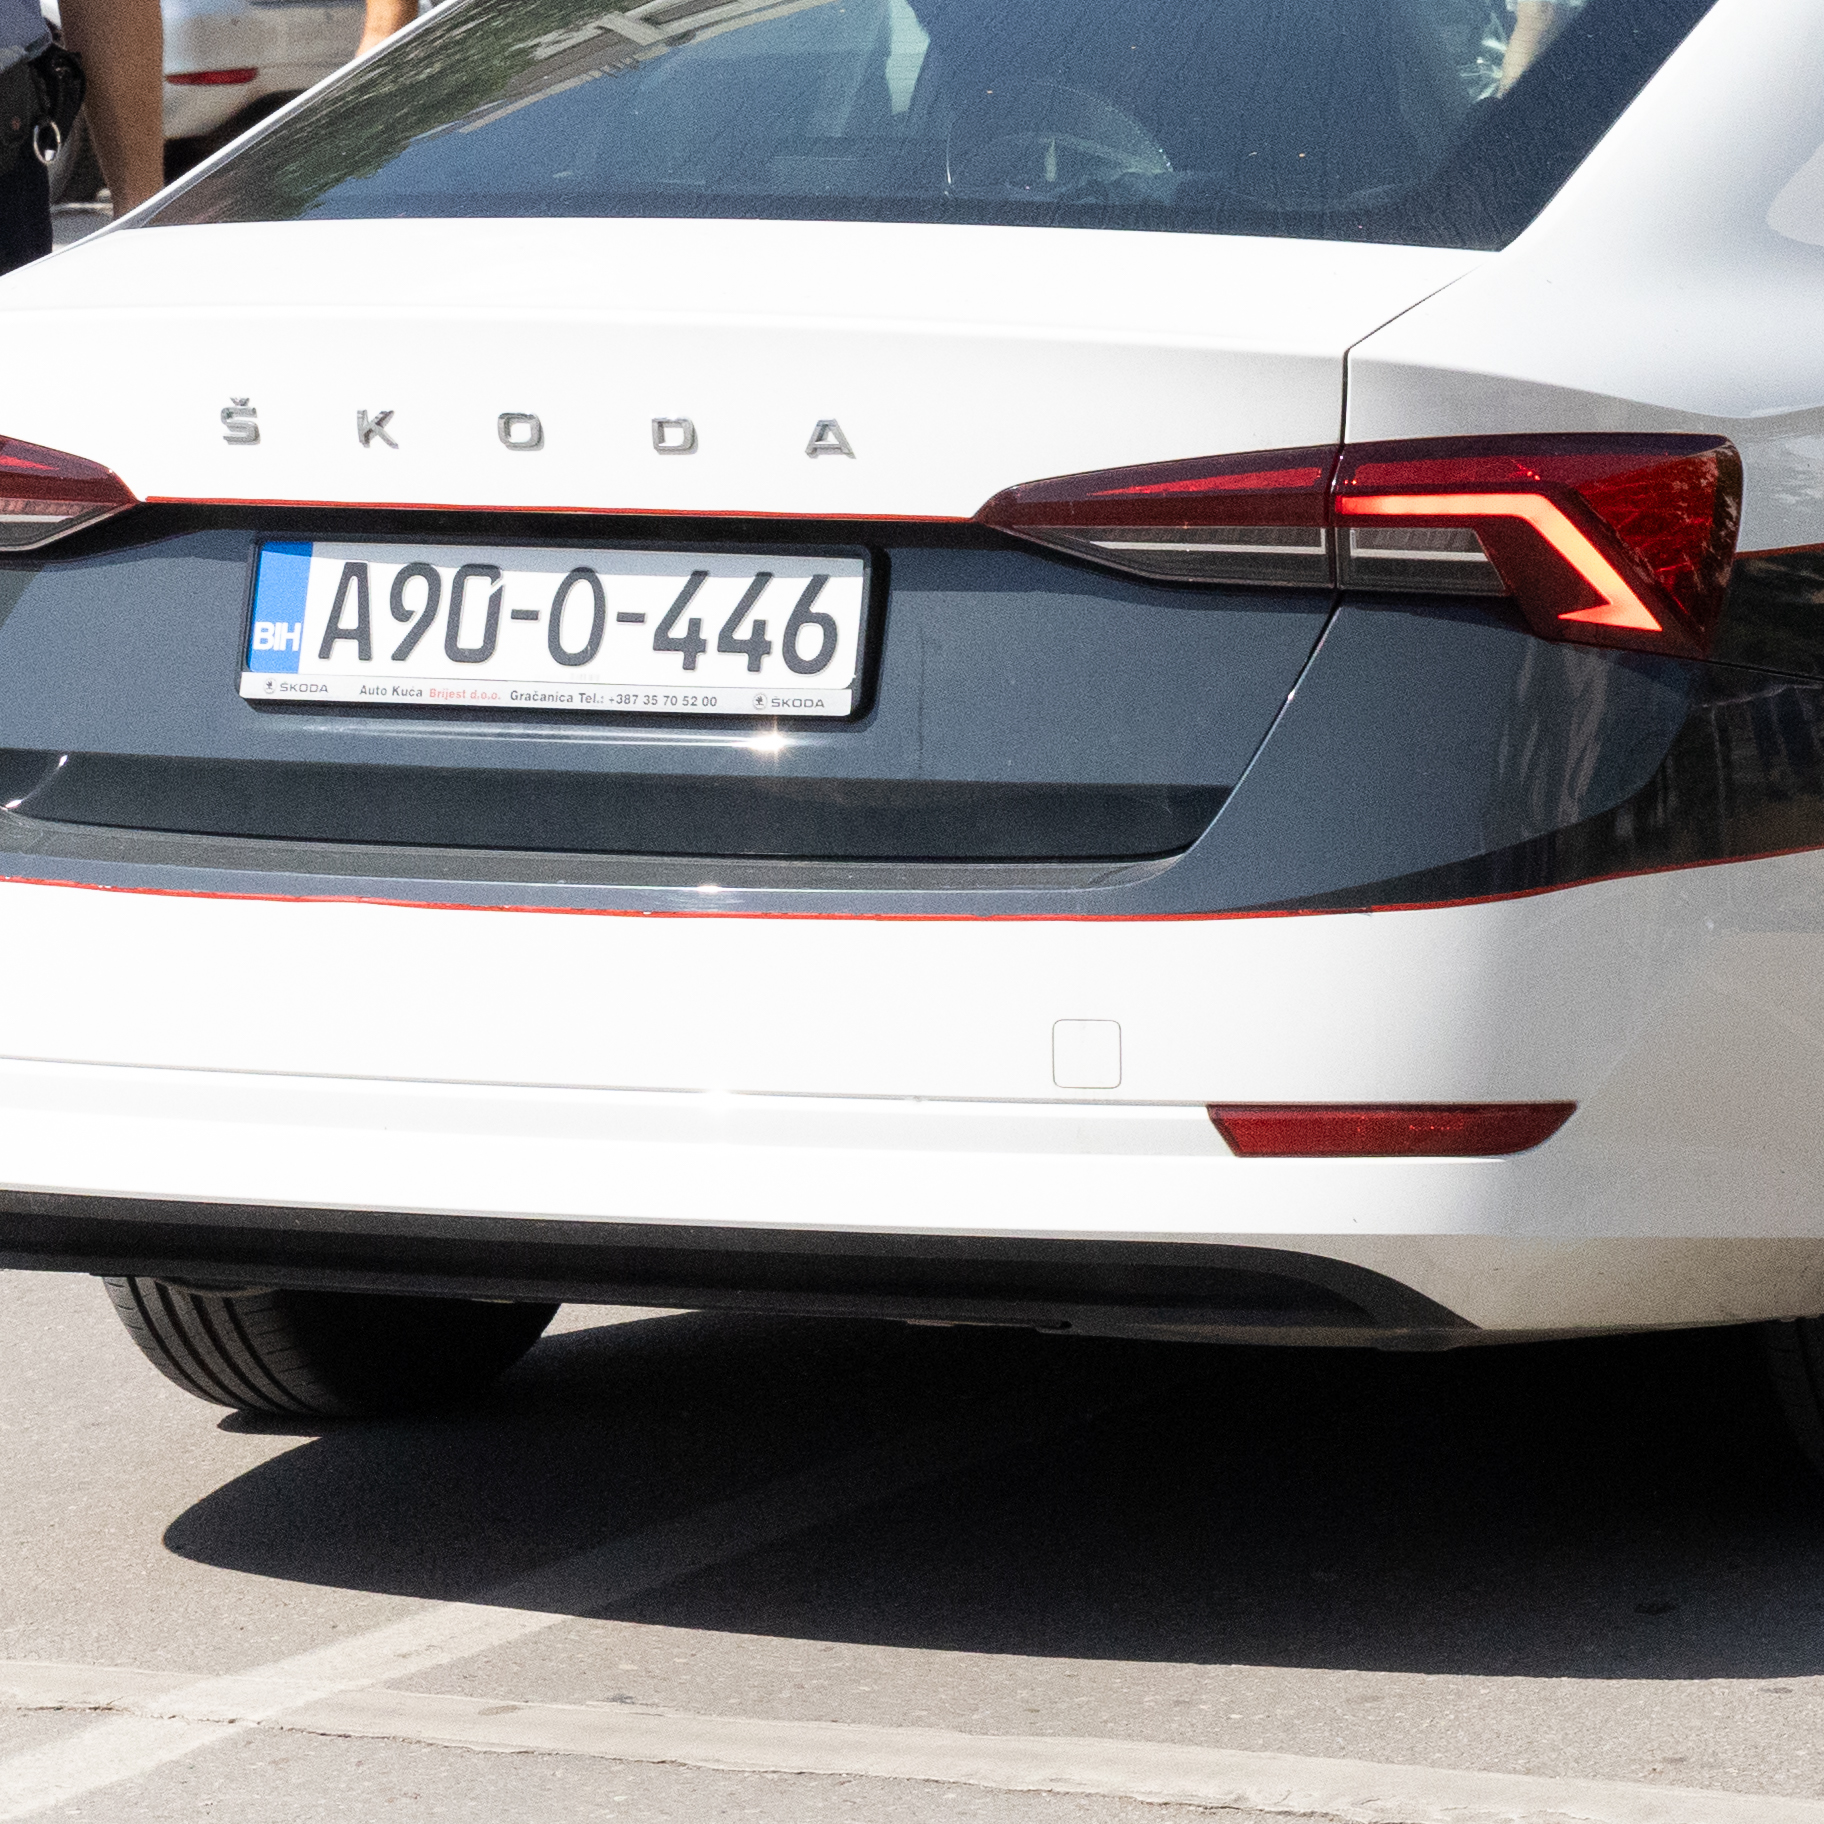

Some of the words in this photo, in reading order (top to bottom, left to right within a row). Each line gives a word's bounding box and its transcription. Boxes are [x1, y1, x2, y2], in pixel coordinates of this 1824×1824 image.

[220, 396, 857, 460] ŠKODA
[252, 621, 301, 651] BIH
[280, 682, 329, 694] ŠKODA
[359, 684, 387, 696] Auto
[392, 685, 423, 697] Kuća
[429, 687, 466, 700] Brijest
[470, 689, 501, 701] d.o.o.
[510, 690, 574, 704] Gračanica
[579, 692, 604, 704] Tel.:
[608, 694, 639, 705] +387
[643, 694, 658, 706] 35
[663, 695, 678, 707] 70
[682, 695, 698, 707] 52
[702, 696, 718, 708] 00
[771, 696, 825, 709] ŠKODA
